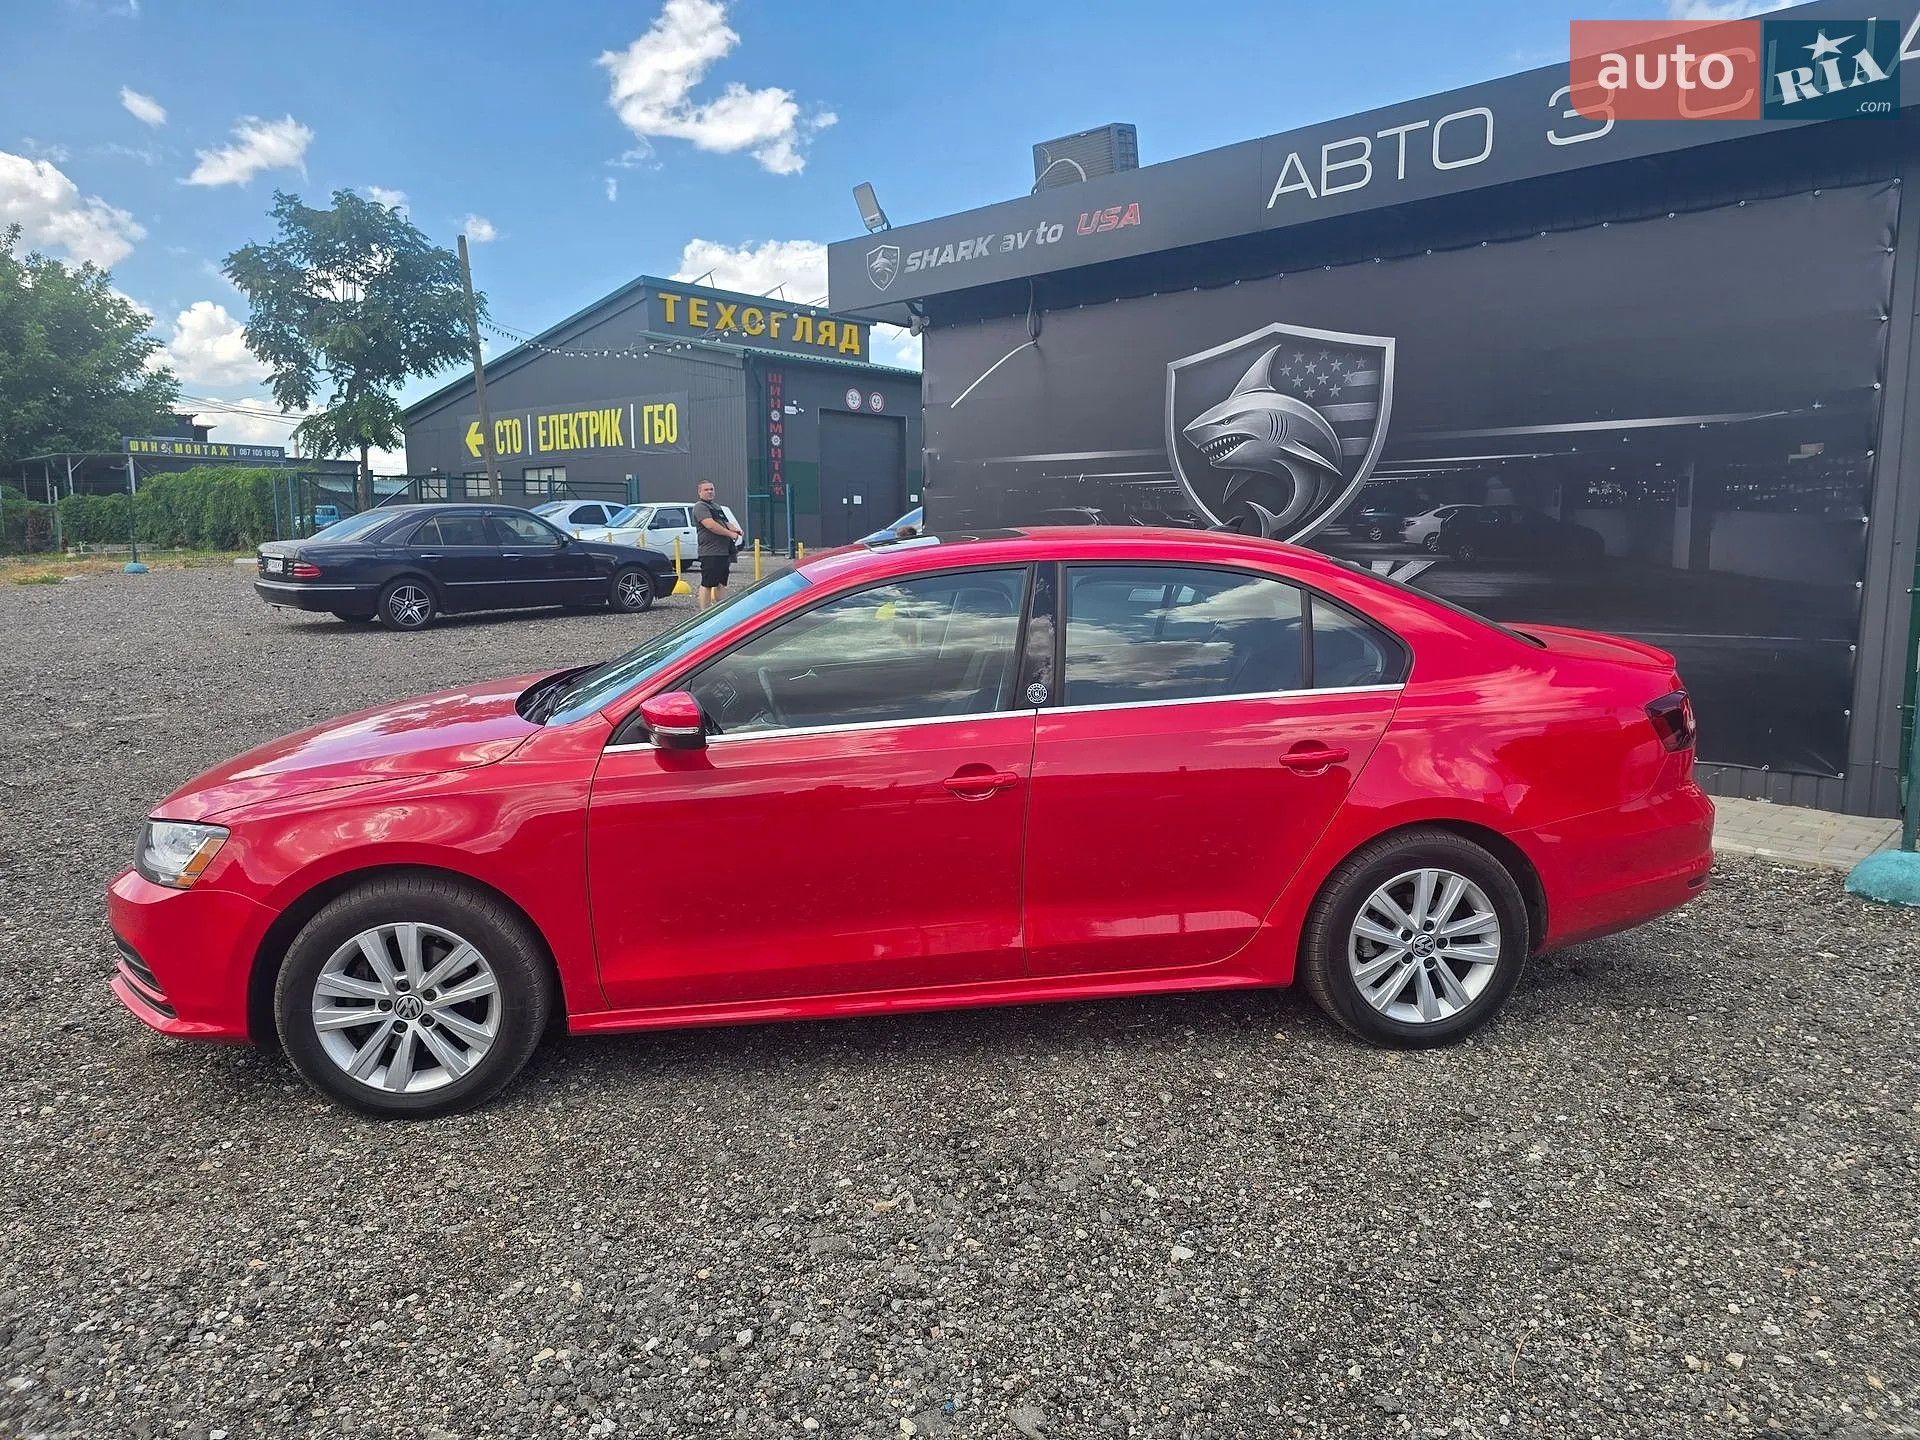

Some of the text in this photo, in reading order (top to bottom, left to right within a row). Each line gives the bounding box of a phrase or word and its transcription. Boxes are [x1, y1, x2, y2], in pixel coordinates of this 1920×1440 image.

[1266, 106, 1494, 209] АВТО
[903, 233, 997, 275] SHARK
[1075, 201, 1142, 237] USA
[657, 292, 861, 356] ТЕХОГЛЯД
[494, 402, 678, 455] СТО ЕЛЕКТРИК ГБО
